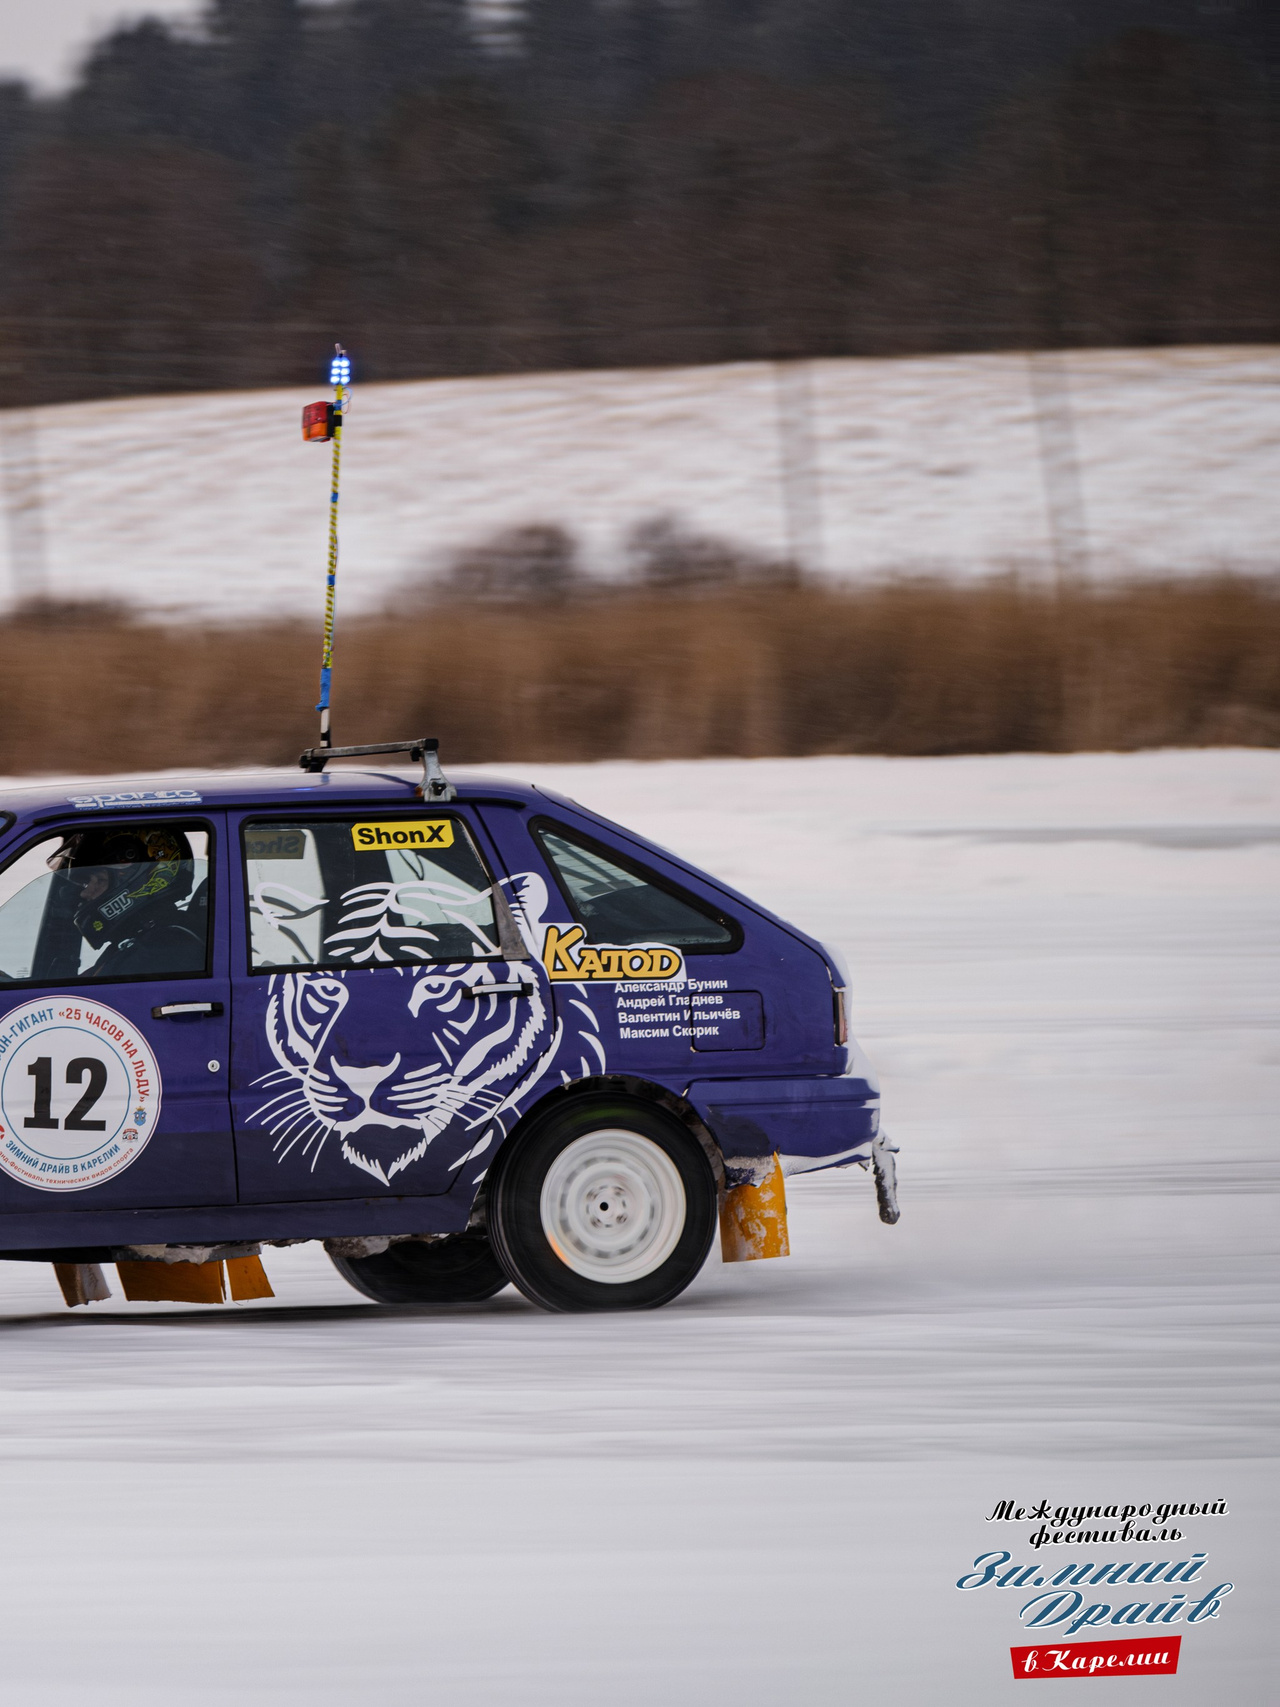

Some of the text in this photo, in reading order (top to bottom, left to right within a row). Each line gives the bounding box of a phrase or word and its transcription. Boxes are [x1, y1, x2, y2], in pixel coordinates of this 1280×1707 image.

[67, 789, 198, 808] sparco
[357, 824, 446, 845] ShonX
[104, 891, 132, 917] agv
[614, 979, 728, 993] Александр Бунин
[616, 994, 724, 1009] Андрей Гладнев
[618, 1009, 741, 1023] Валентин Ильичёв
[619, 1024, 720, 1039] Максим Скорик
[58, 1007, 82, 1021] «25
[85, 1011, 125, 1042] ЧАСОВ
[121, 1039, 138, 1059] НА
[132, 1059, 150, 1103] ЛЬДУ»
[23, 1056, 108, 1131] 12
[5, 1140, 121, 1174] ЗИМНИЙ ДРАЙВ В КАРЕЛИИ
[46, 1176, 90, 1184] технических
[91, 1166, 112, 1179] видов
[113, 1147, 134, 1168] спорта
